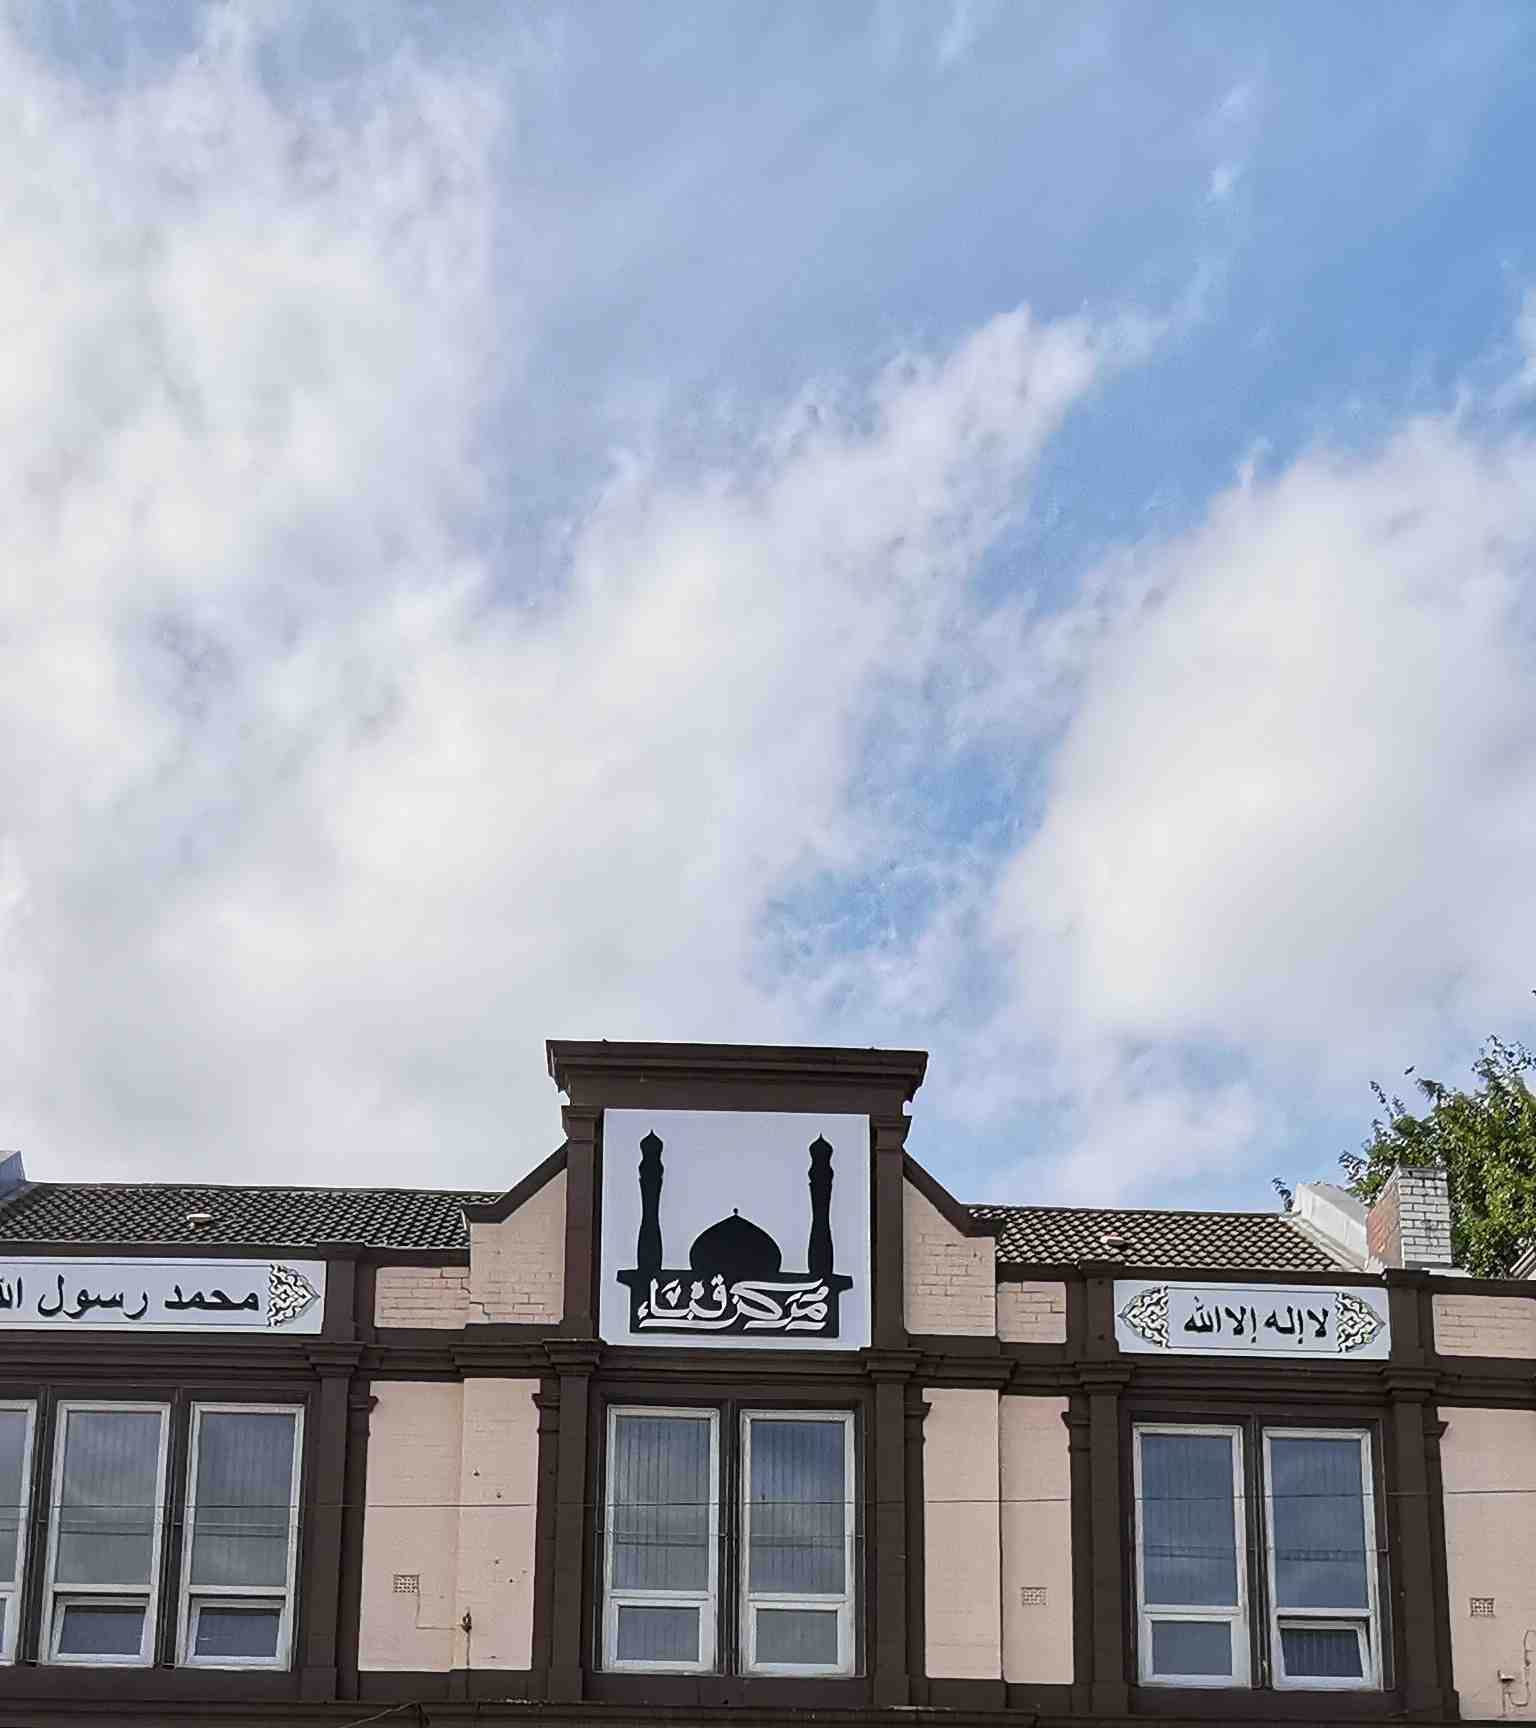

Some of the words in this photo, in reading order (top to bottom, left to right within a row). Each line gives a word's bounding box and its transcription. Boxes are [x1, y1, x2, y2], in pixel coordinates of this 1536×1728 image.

[38, 1273, 150, 1320] رسول
[165, 1284, 261, 1312] محمد
[1183, 1295, 1222, 1334] الله
[1306, 1307, 1330, 1338] لا
